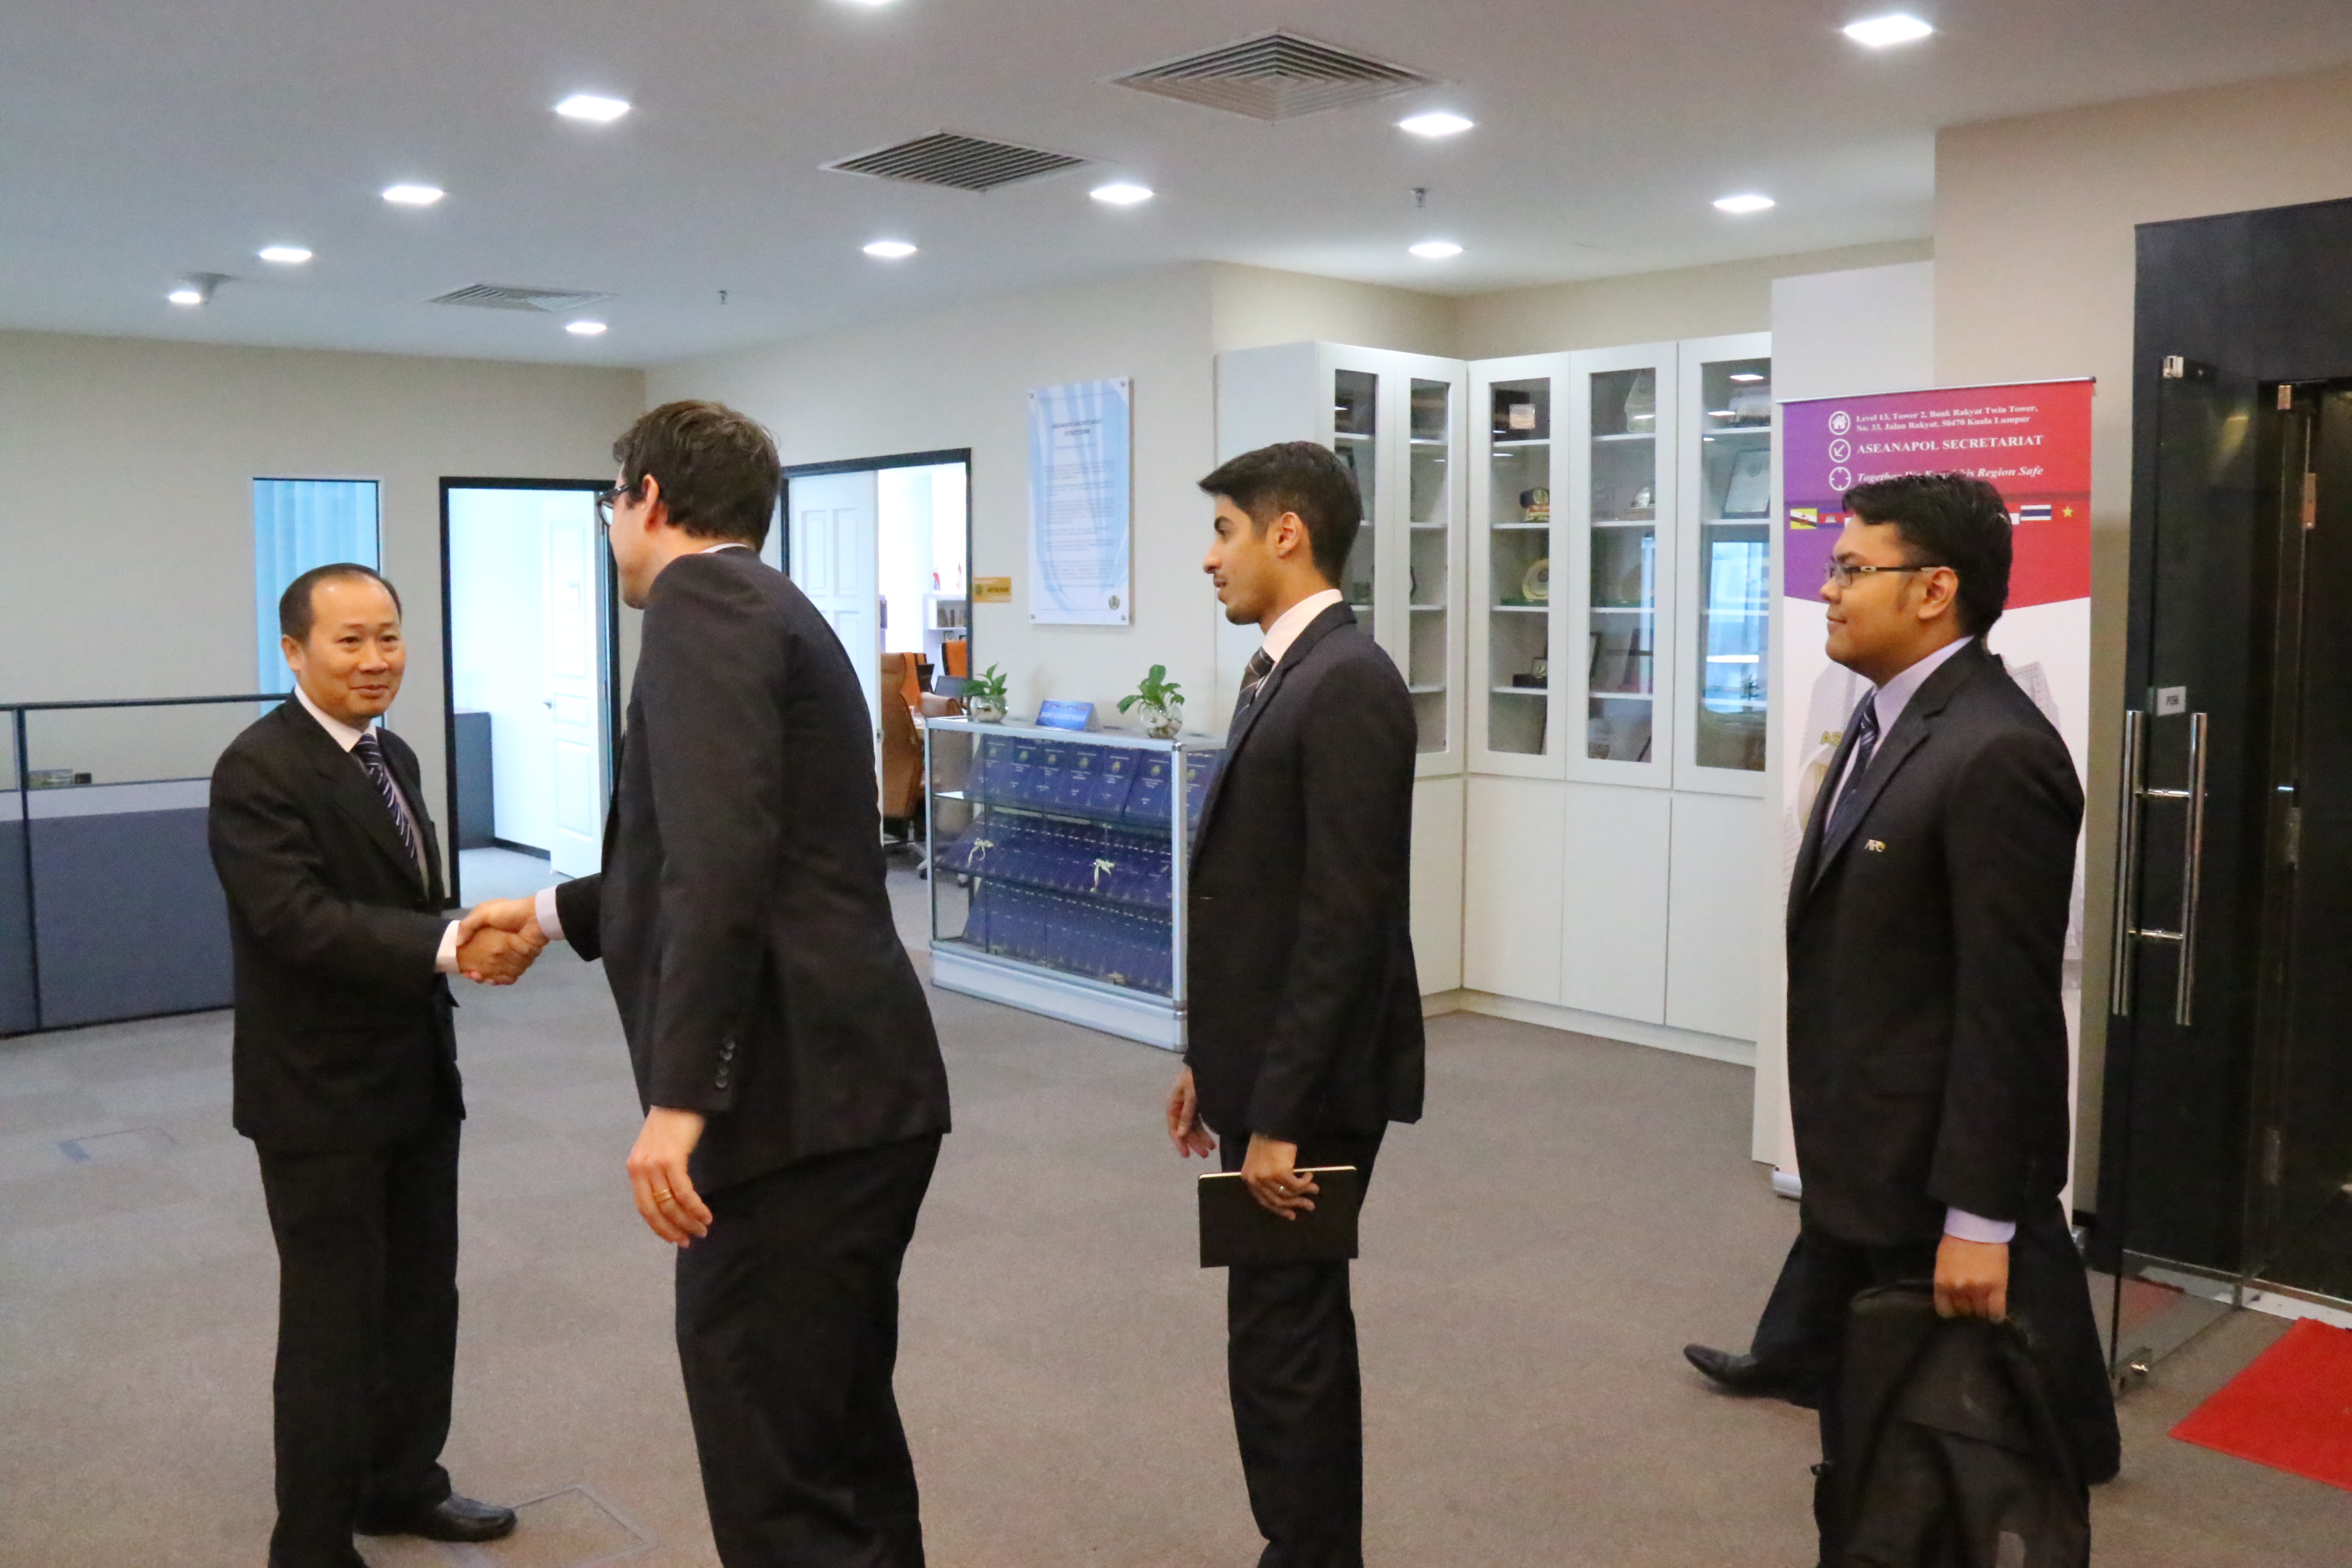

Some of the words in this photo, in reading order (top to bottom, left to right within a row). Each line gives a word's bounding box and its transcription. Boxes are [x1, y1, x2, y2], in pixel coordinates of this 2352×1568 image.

[1941, 419, 1966, 427] 50470
[1967, 417, 1992, 426] Kuala
[1994, 416, 2031, 425] Lumpur
[1857, 440, 1939, 454] ASEANAPOL
[1942, 435, 2044, 450] SECRETARIAT
[1977, 467, 2016, 478] Region
[2018, 465, 2044, 477] Safe
